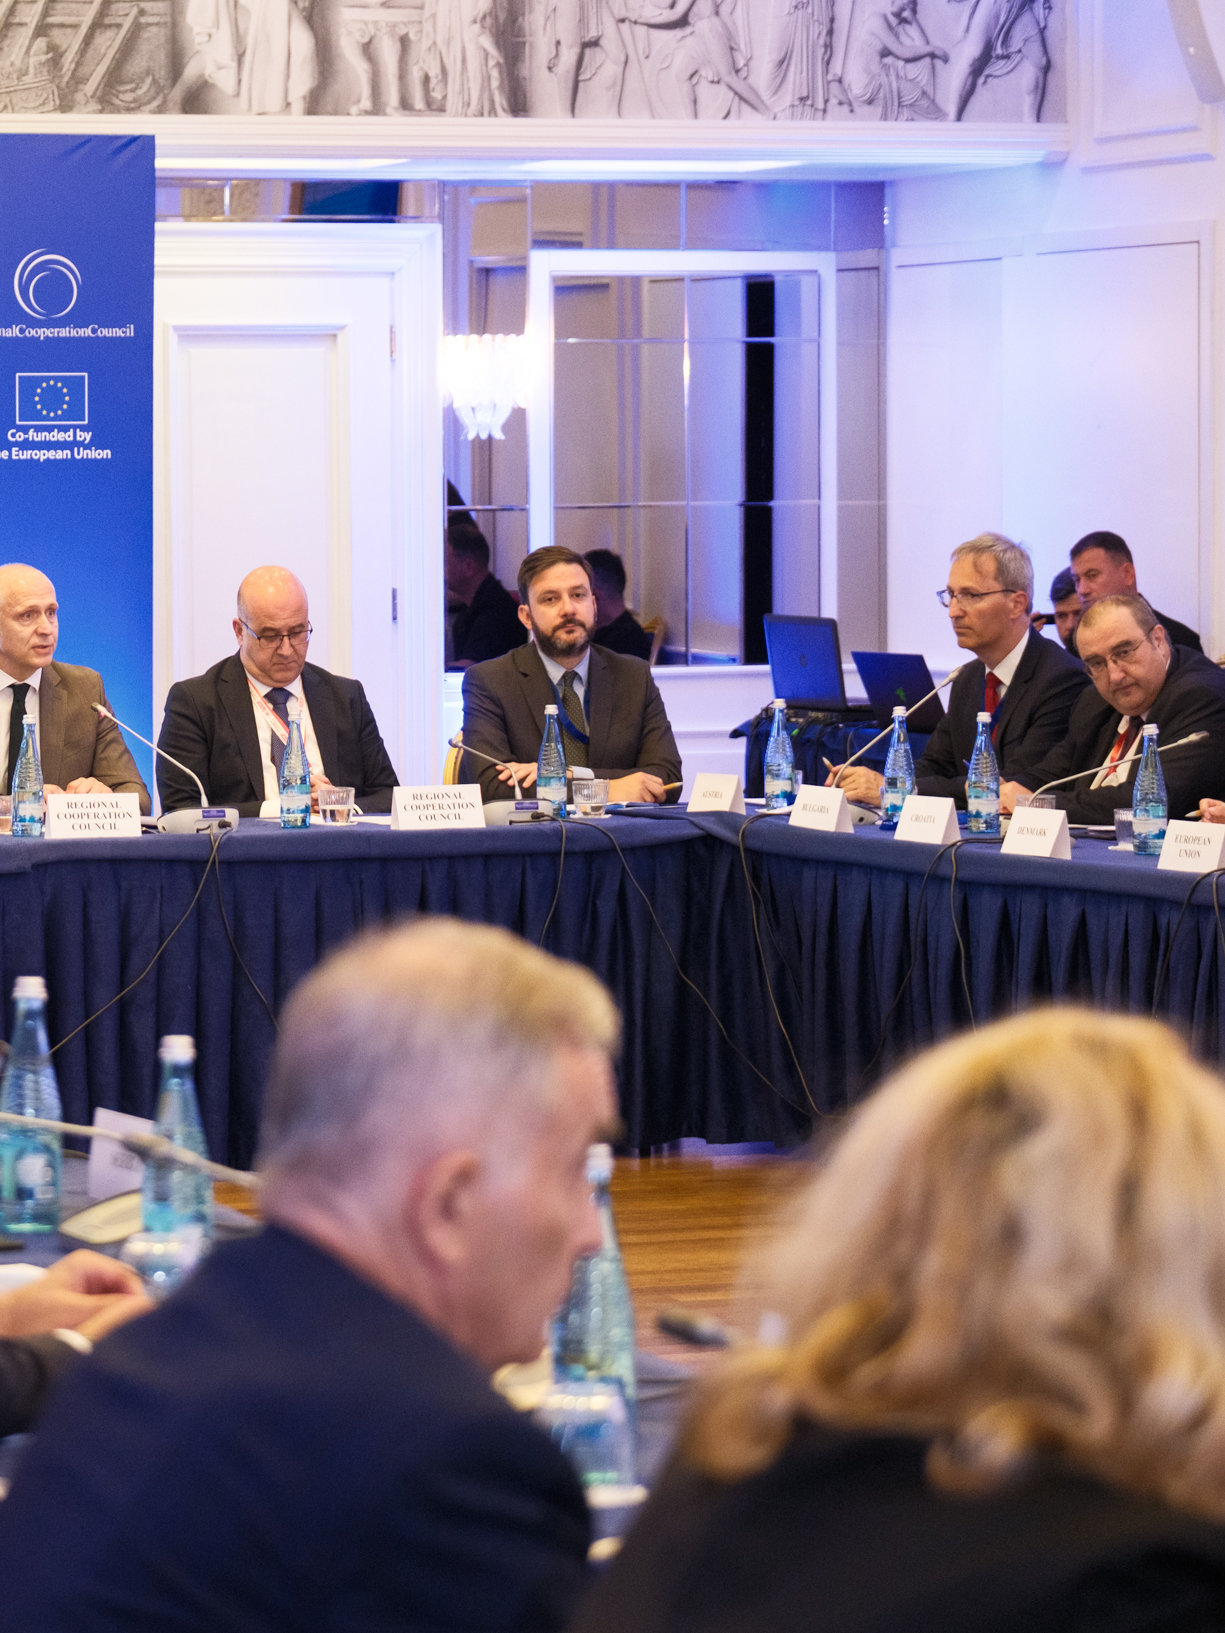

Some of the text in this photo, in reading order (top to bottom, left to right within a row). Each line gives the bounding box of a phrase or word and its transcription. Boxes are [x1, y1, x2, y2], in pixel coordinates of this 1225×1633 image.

[7, 429, 92, 444] Co-funded by
[12, 447, 71, 462] European
[74, 446, 112, 460] Union
[412, 791, 465, 801] REGIONAL
[66, 801, 122, 810] REGIONAL
[403, 801, 476, 812] COOPERATION
[801, 803, 830, 814] BULGARIA
[56, 811, 133, 820] COOPERATION
[418, 812, 465, 822] COUNCIL
[71, 822, 120, 831] COUNCIL
[1016, 826, 1048, 837] DENMARK
[1174, 834, 1212, 846] EUROPEAN
[1179, 848, 1202, 859] UNION
